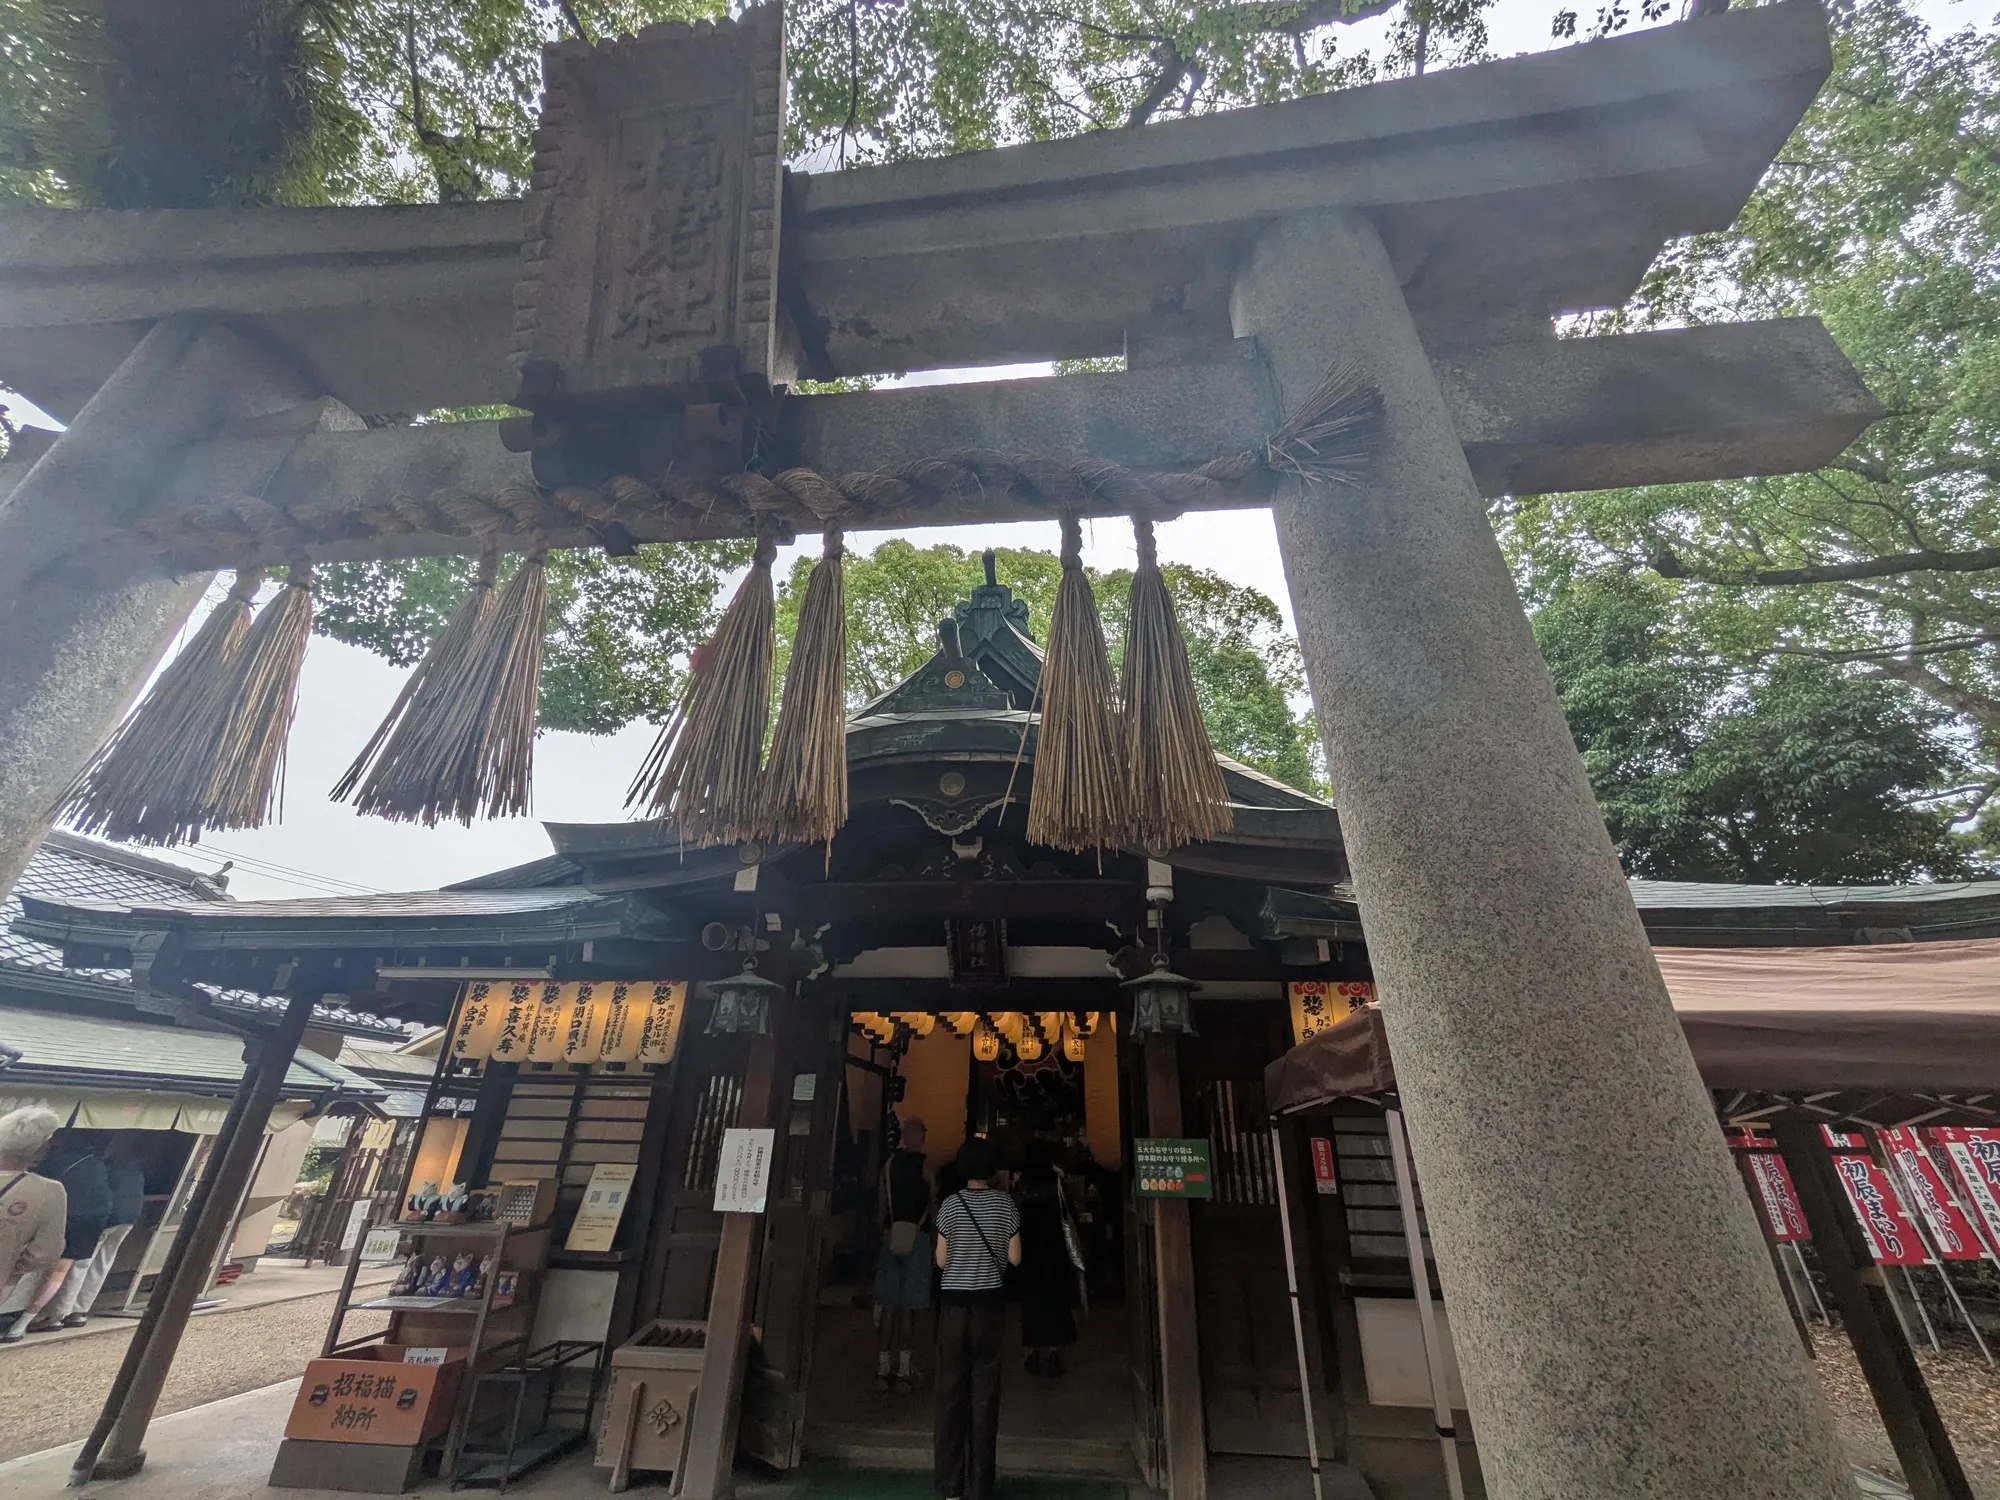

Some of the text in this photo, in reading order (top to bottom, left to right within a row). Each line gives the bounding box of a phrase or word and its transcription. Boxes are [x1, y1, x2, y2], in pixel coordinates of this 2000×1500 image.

[1840, 1156, 1904, 1258] 初辰まいり
[332, 1371, 397, 1400] 招福猫
[331, 1403, 377, 1433] 納所
